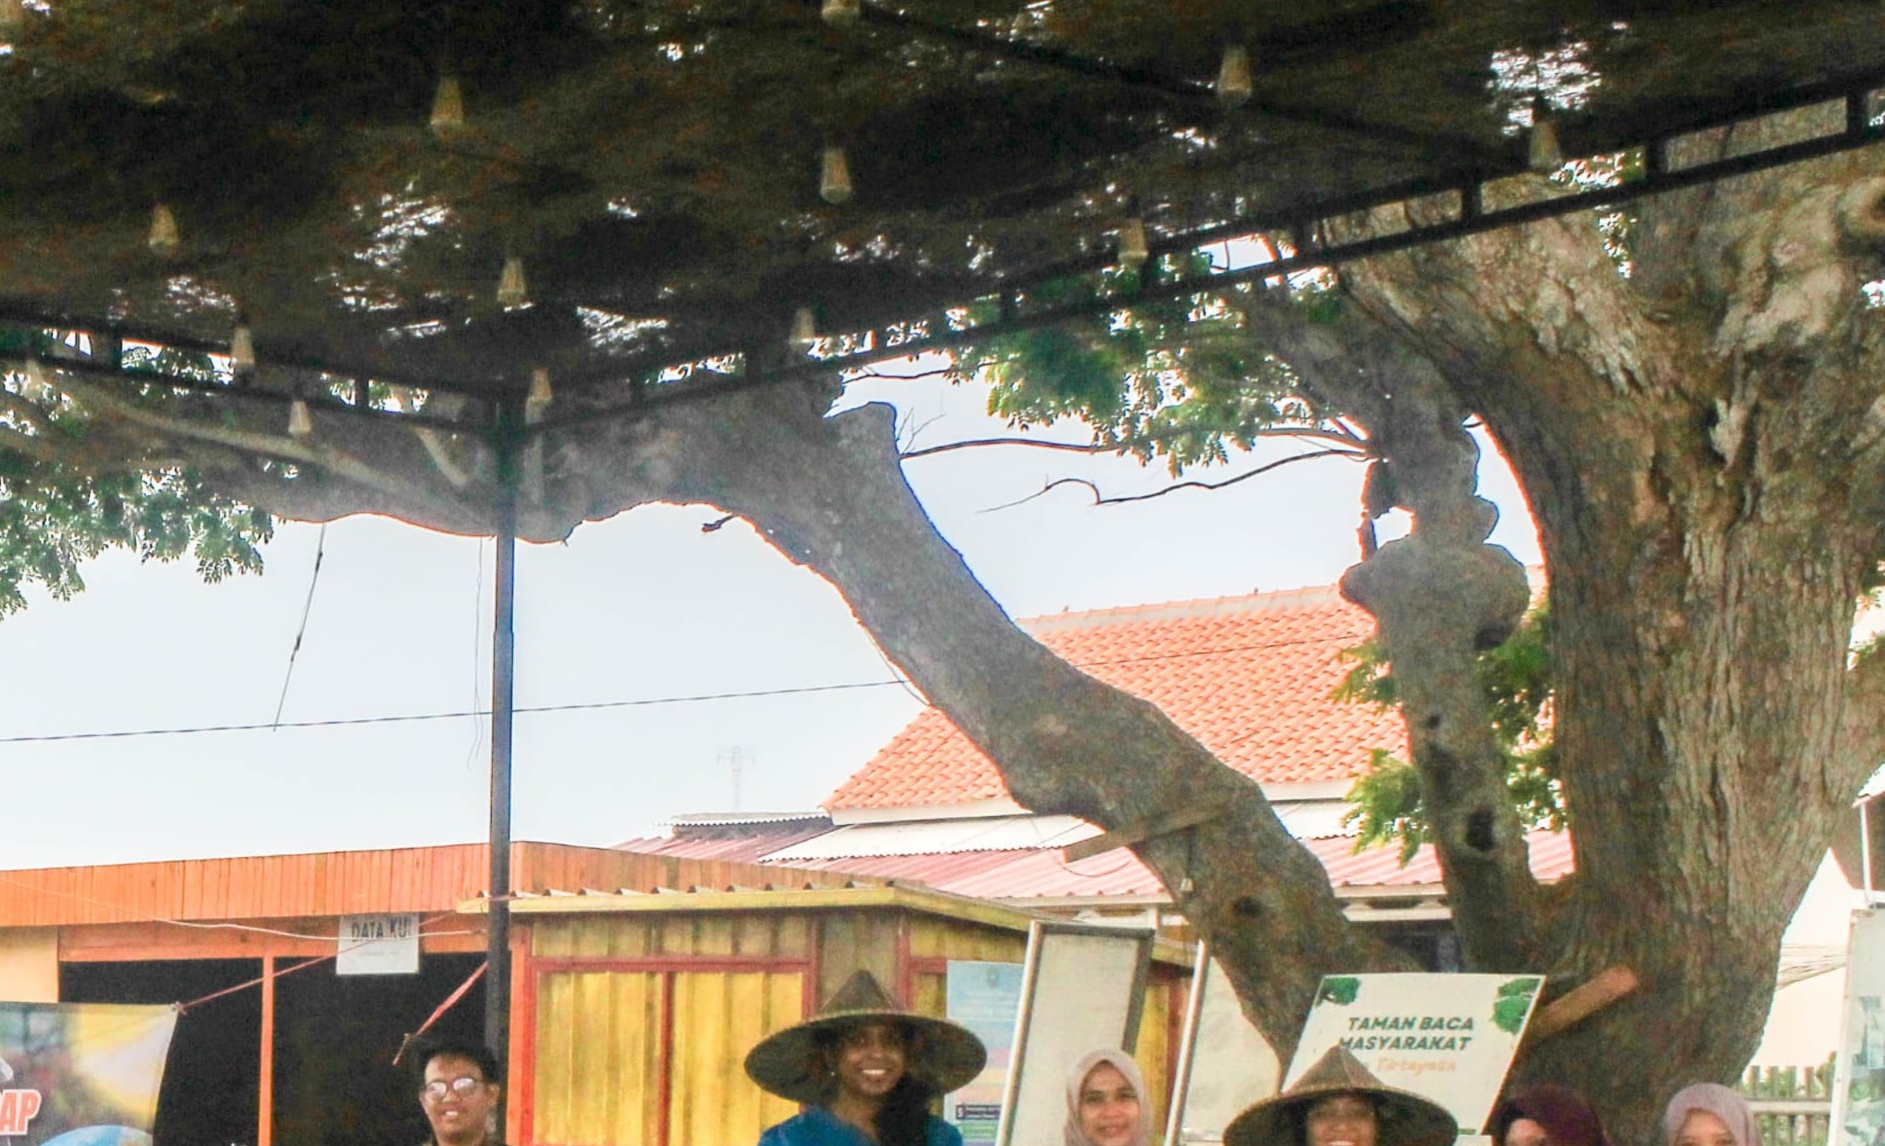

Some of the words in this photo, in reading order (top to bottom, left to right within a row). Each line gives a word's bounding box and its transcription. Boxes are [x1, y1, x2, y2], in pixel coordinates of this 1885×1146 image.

[351, 921, 384, 943] DATA
[1348, 1017, 1416, 1031] TAMAN
[1419, 1016, 1474, 1031] BACA
[1339, 1036, 1472, 1050] MASYARAKAT
